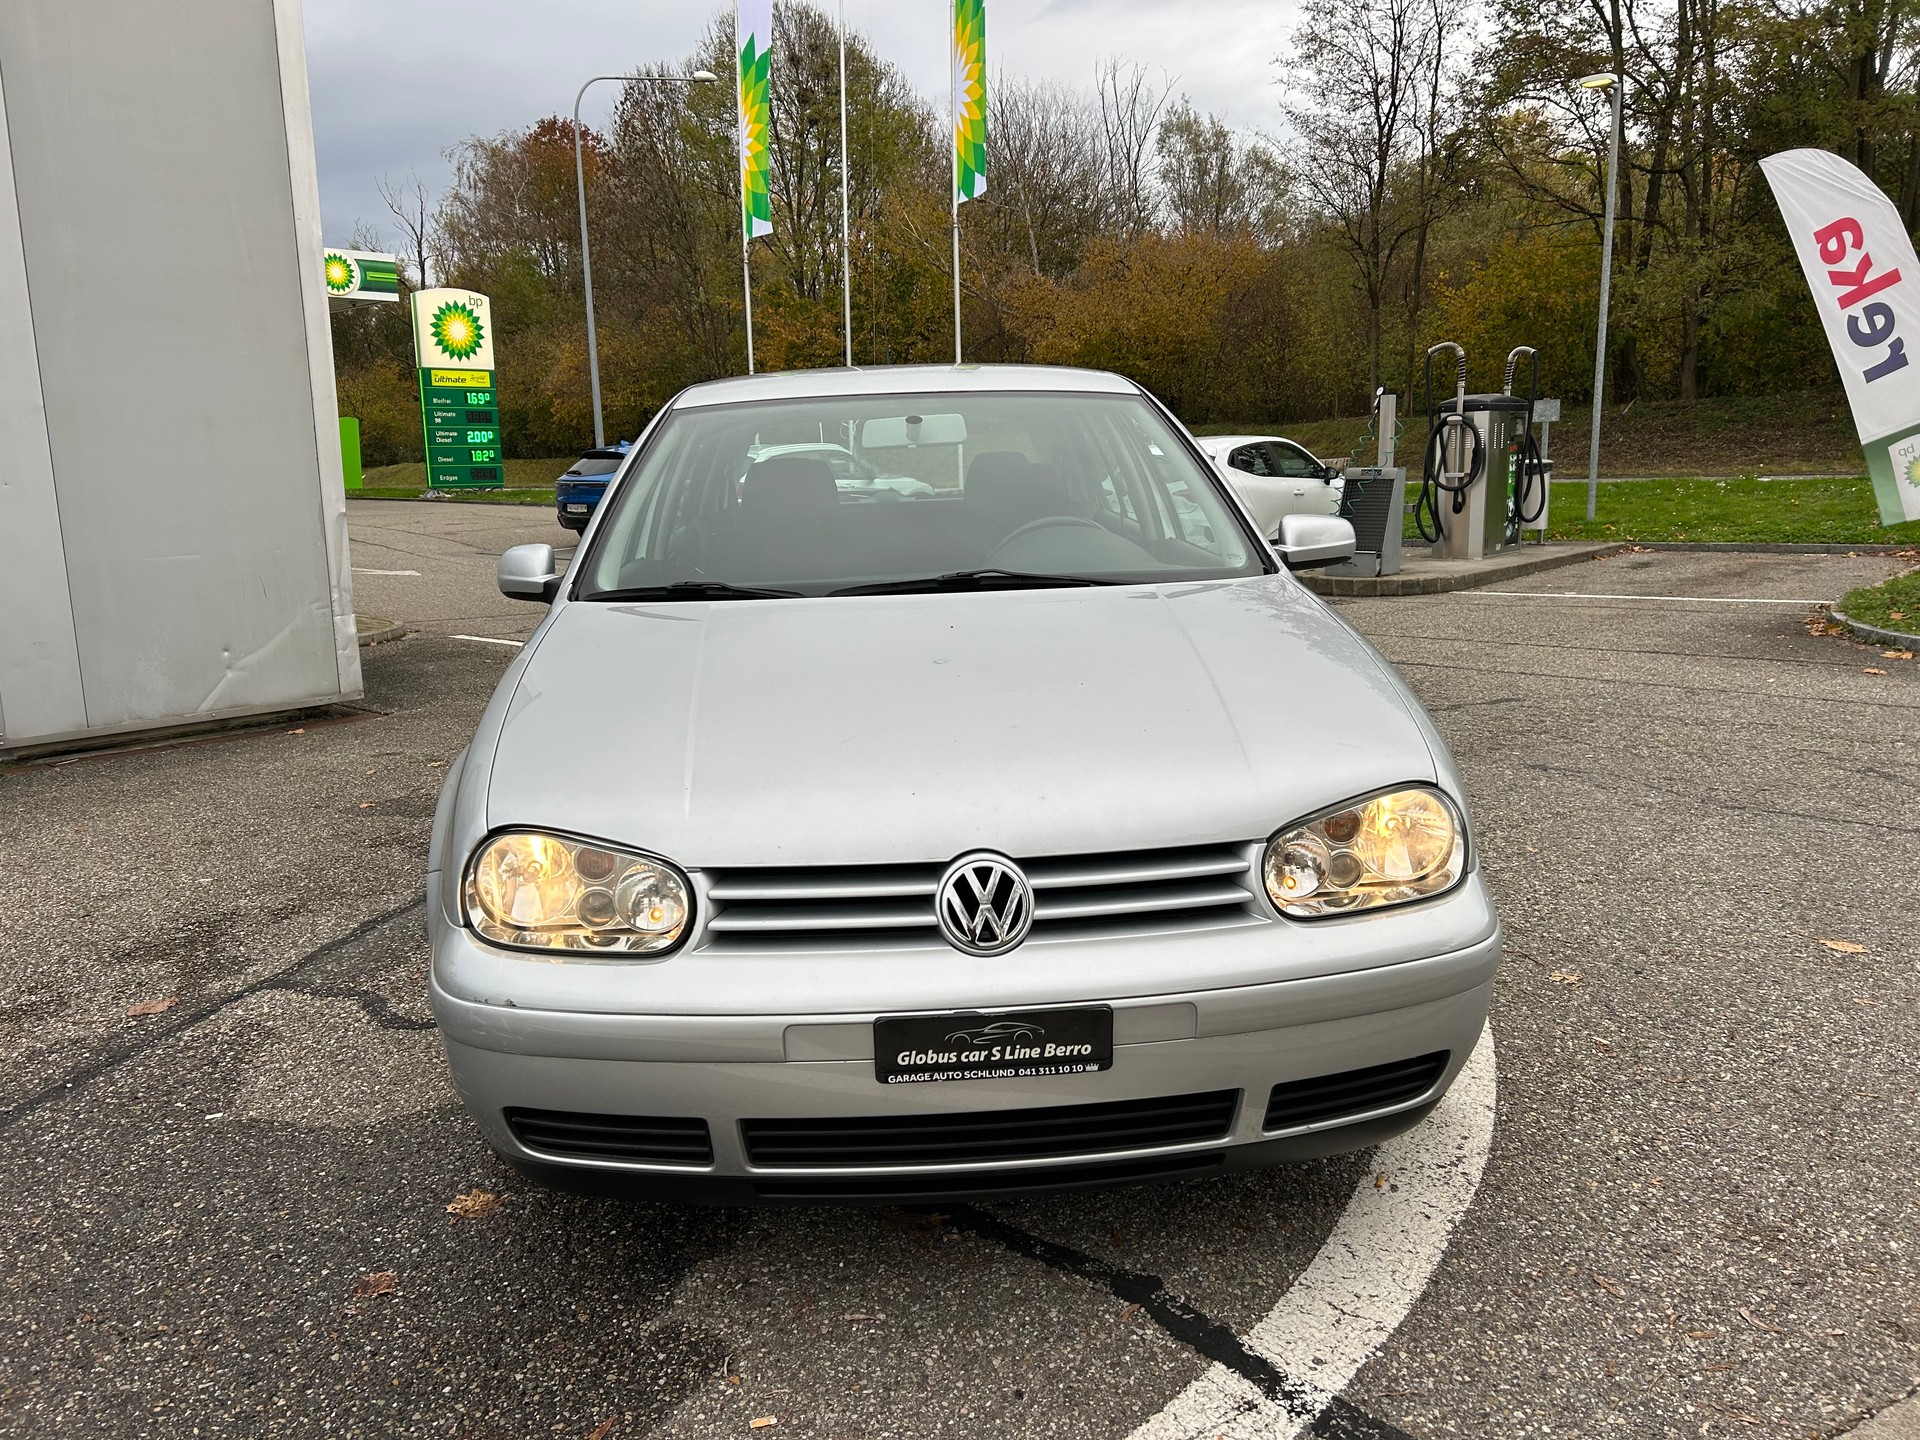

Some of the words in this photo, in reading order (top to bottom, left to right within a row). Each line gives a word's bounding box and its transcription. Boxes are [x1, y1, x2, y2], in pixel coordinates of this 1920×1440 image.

[468, 294, 483, 308] bp
[434, 375, 467, 384] ultimate
[433, 410, 457, 418] Ultimate
[440, 474, 458, 482] Erdgas
[896, 1049, 958, 1066] Globus
[960, 1050, 989, 1063] car
[990, 1046, 1002, 1061] S
[1004, 1044, 1041, 1060] Line
[1043, 1042, 1092, 1058] Berro
[887, 1073, 932, 1084] GARAGE
[932, 1071, 962, 1081] AUTO
[963, 1068, 1016, 1079] SCHLUND
[1018, 1067, 1037, 1076] 041
[1038, 1066, 1056, 1075] 311
[1058, 1065, 1071, 1074] 10
[1071, 1064, 1084, 1073] 10
